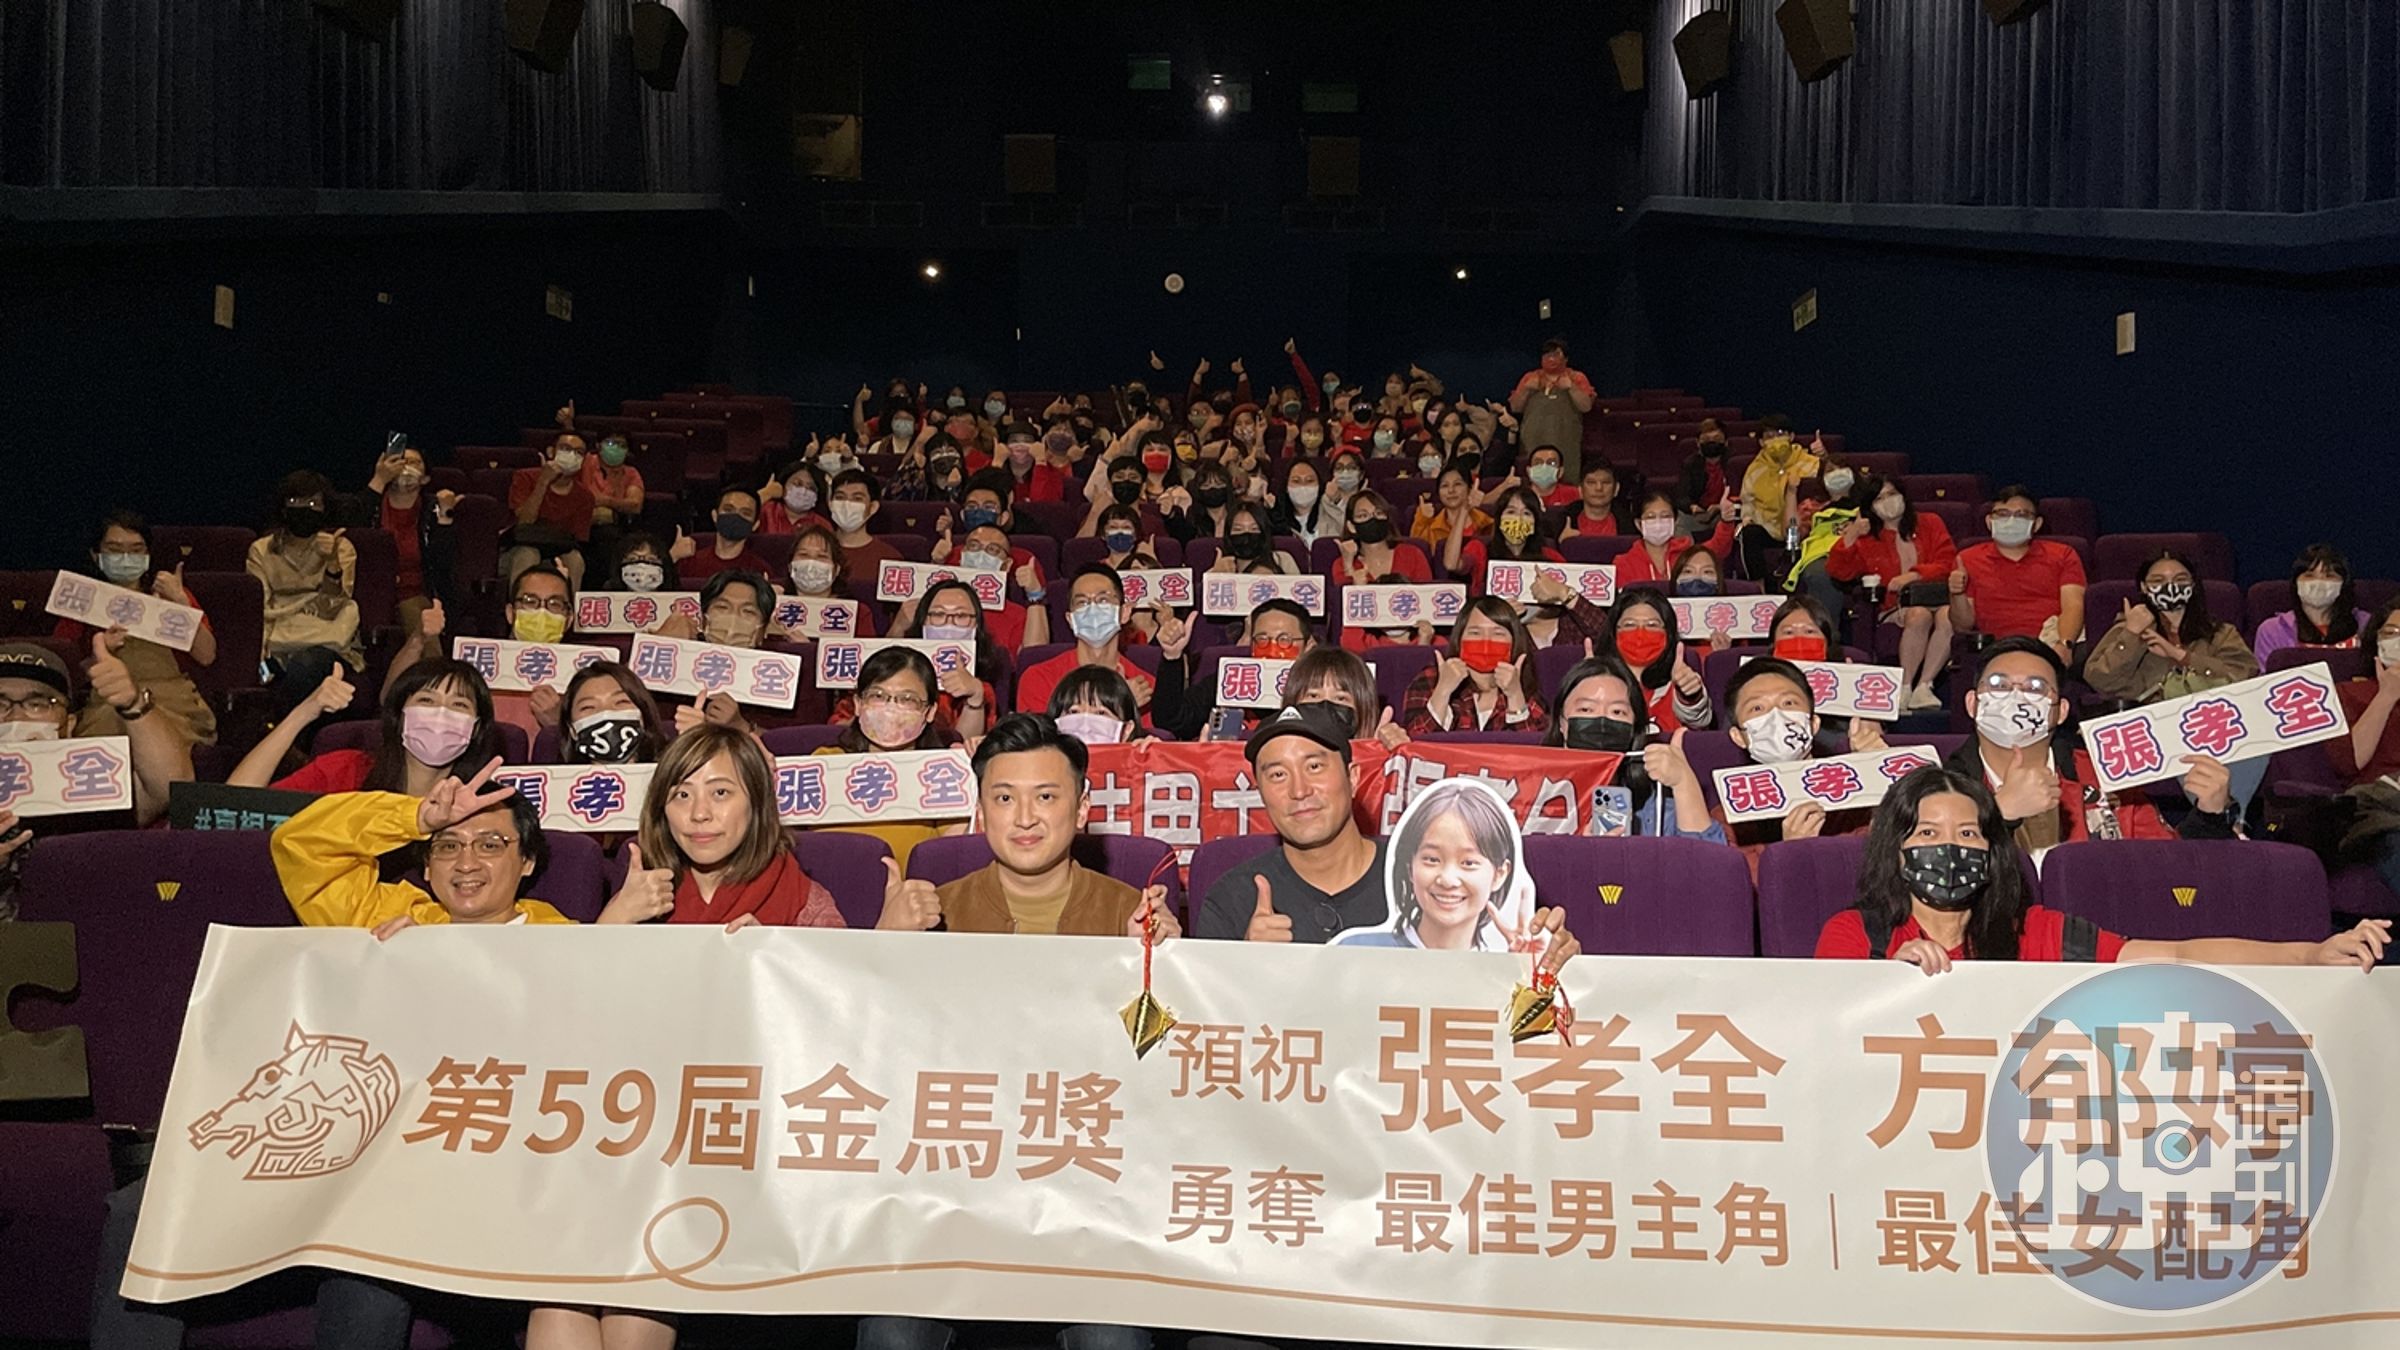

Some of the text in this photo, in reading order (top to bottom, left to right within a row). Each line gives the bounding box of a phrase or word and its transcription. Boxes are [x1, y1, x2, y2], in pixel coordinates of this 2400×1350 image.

[54, 580, 192, 641] 張孝全
[777, 602, 851, 633] 孝全
[1208, 578, 1321, 609] 張孝全
[1349, 592, 1460, 618] 張孝全
[636, 643, 794, 698] 張孝全
[824, 645, 968, 679] 張全
[1224, 665, 1291, 700] 張
[1806, 669, 1895, 710] 孝全
[2097, 678, 2334, 780] 張孝全
[776, 761, 967, 812] 張孝全
[1168, 1022, 1327, 1105] 預祝
[1378, 1005, 1787, 1143] 張孝全
[403, 1055, 1124, 1184] 第59屆金馬獎
[1164, 1163, 2311, 1281] 勇奪 最佳男主角 最佳女配角
